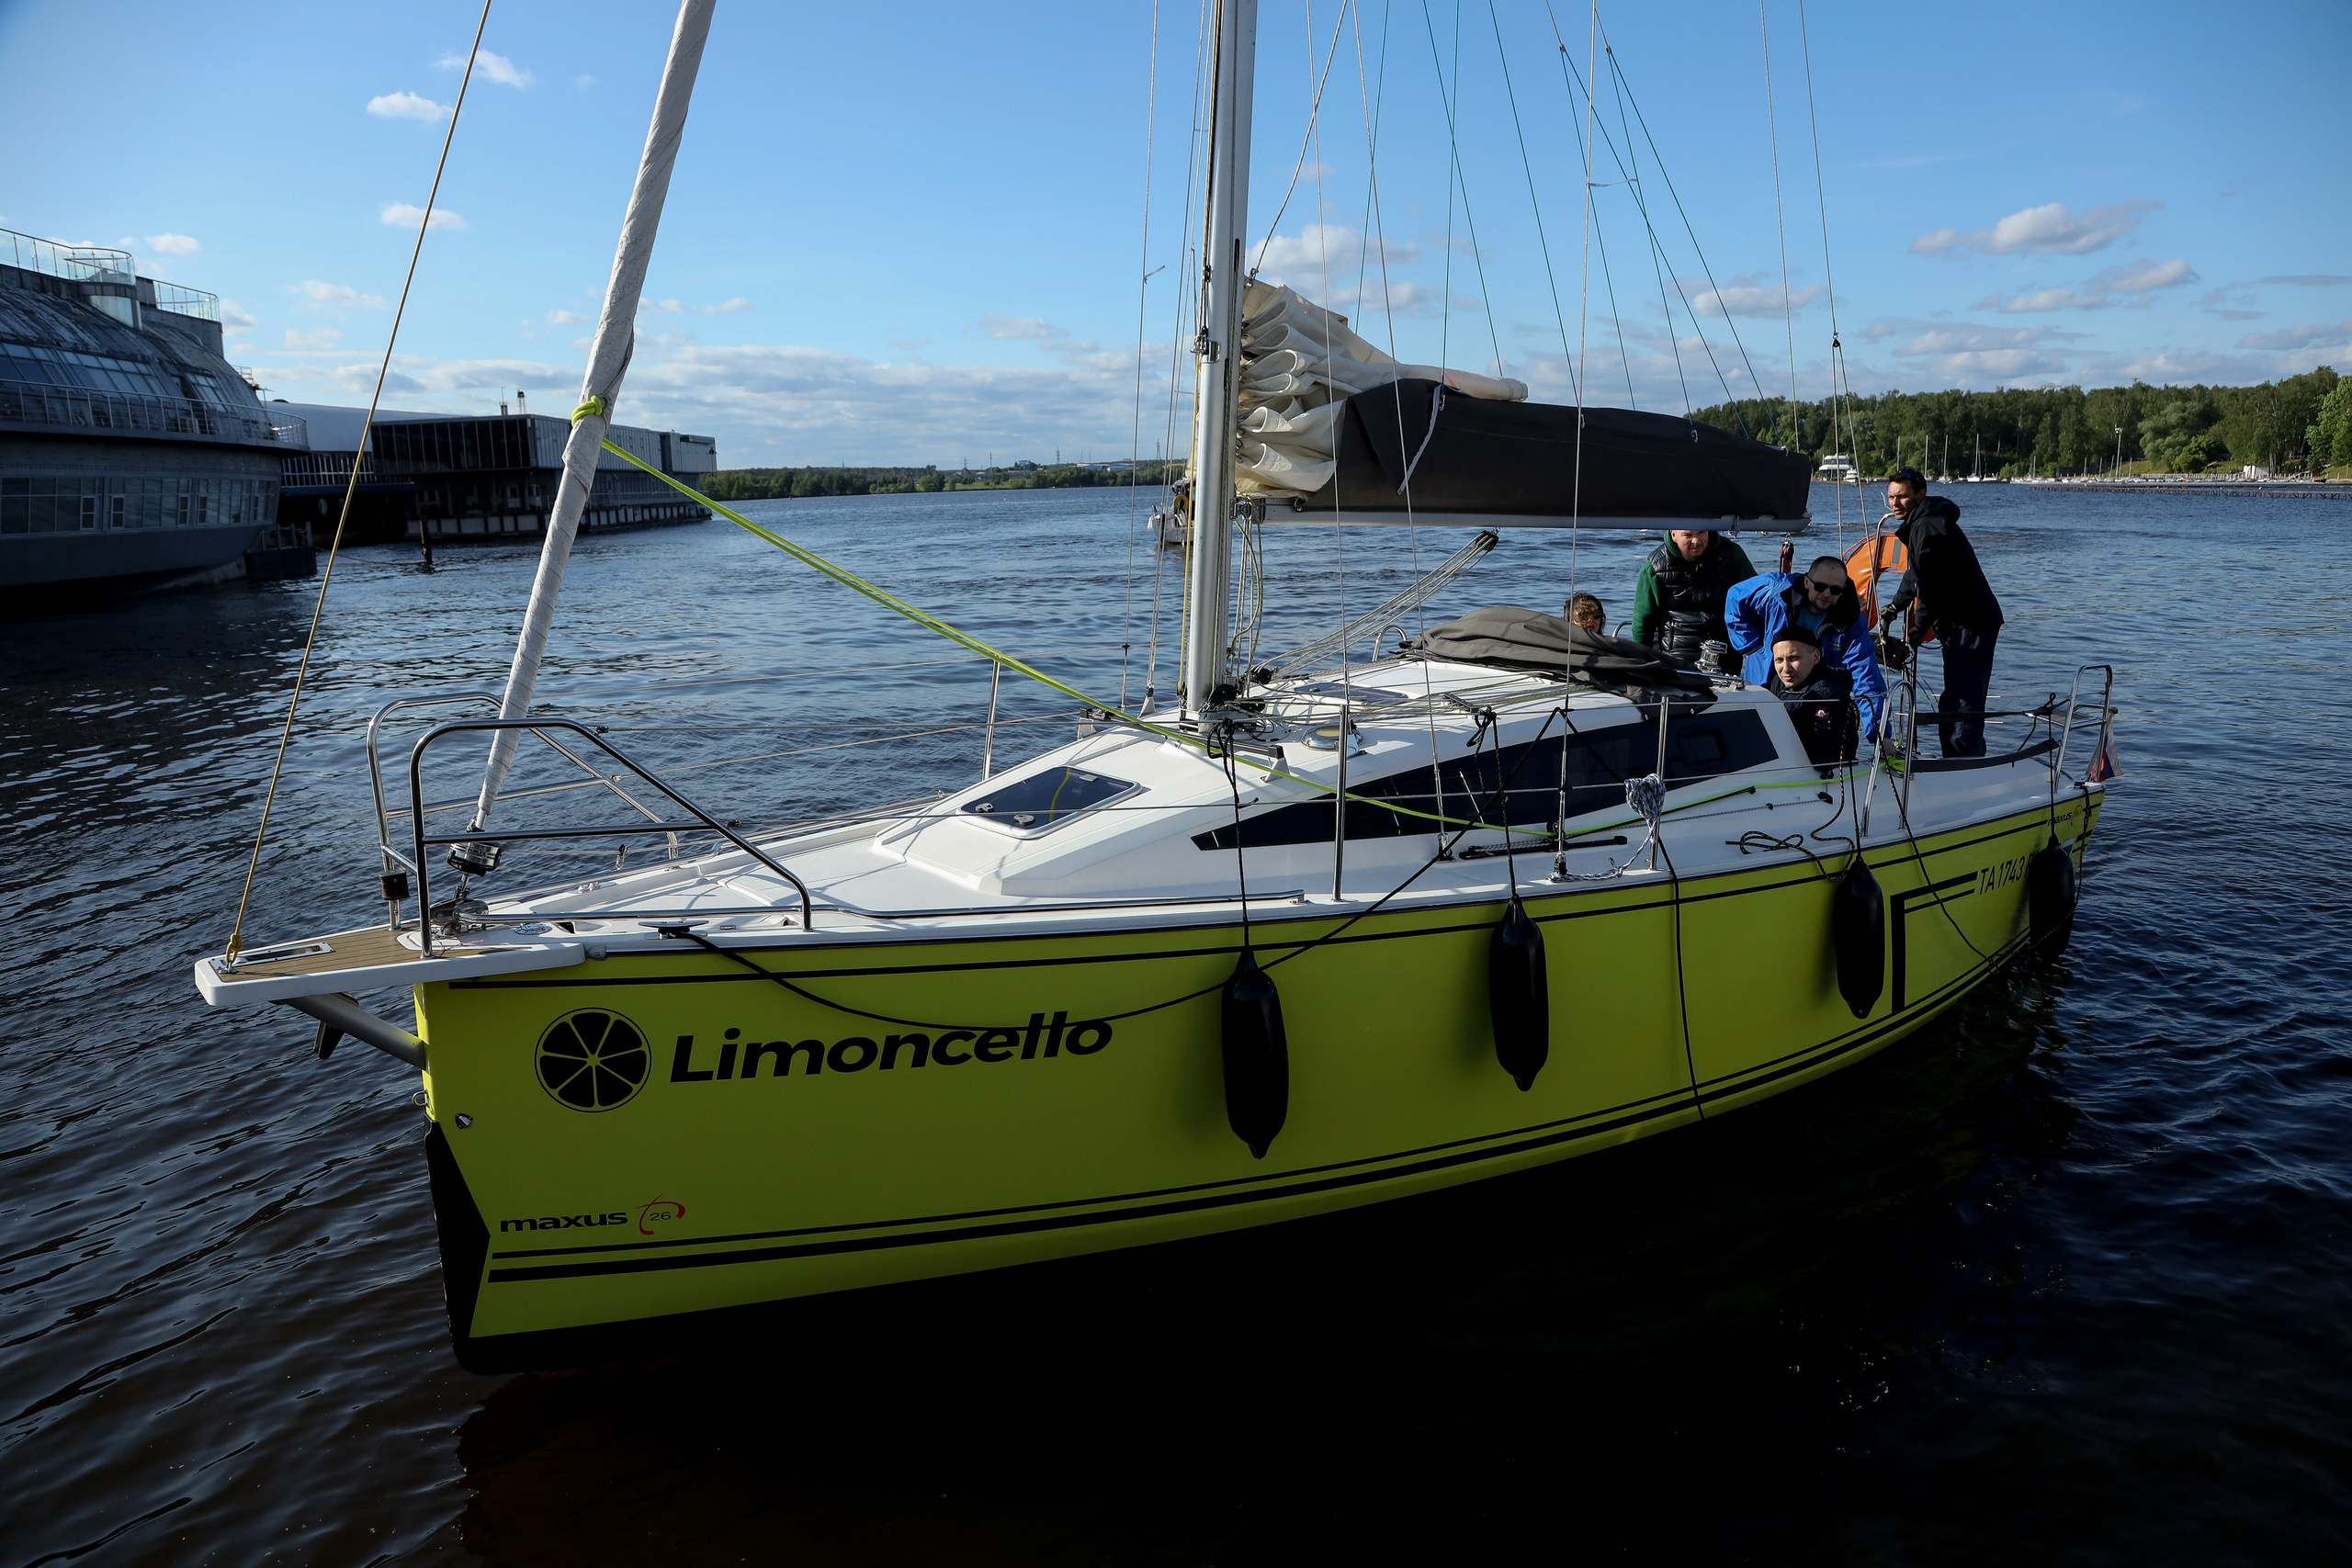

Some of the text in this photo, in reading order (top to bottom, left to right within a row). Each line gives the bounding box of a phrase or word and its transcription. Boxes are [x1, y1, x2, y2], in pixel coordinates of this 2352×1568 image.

[670, 1011, 1113, 1082] Limoncello
[501, 1212, 671, 1233] maxus 26
